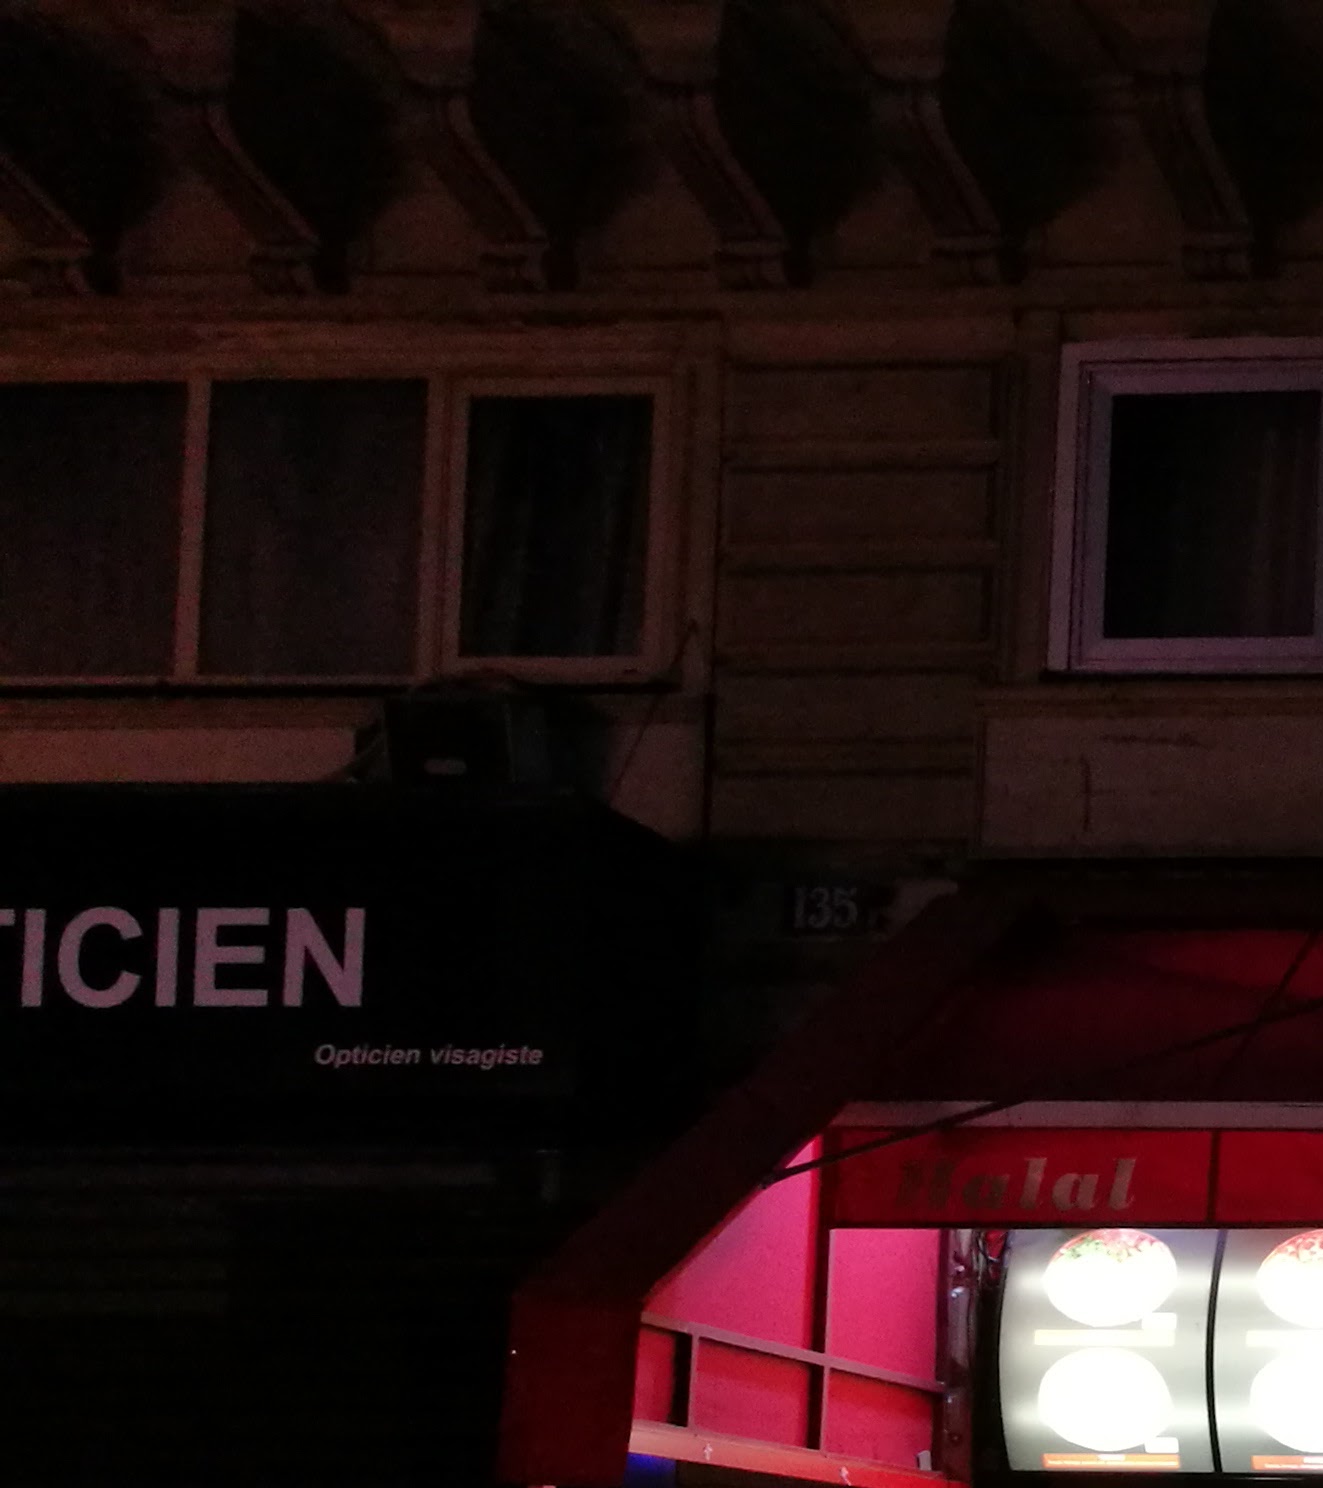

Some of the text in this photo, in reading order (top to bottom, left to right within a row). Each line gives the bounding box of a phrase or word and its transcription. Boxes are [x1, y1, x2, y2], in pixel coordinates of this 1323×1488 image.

[793, 885, 859, 930] 135
[0, 905, 366, 1009] ICIEN
[313, 1042, 544, 1072] Opticien visagiste
[894, 1156, 1138, 1212] Halal
